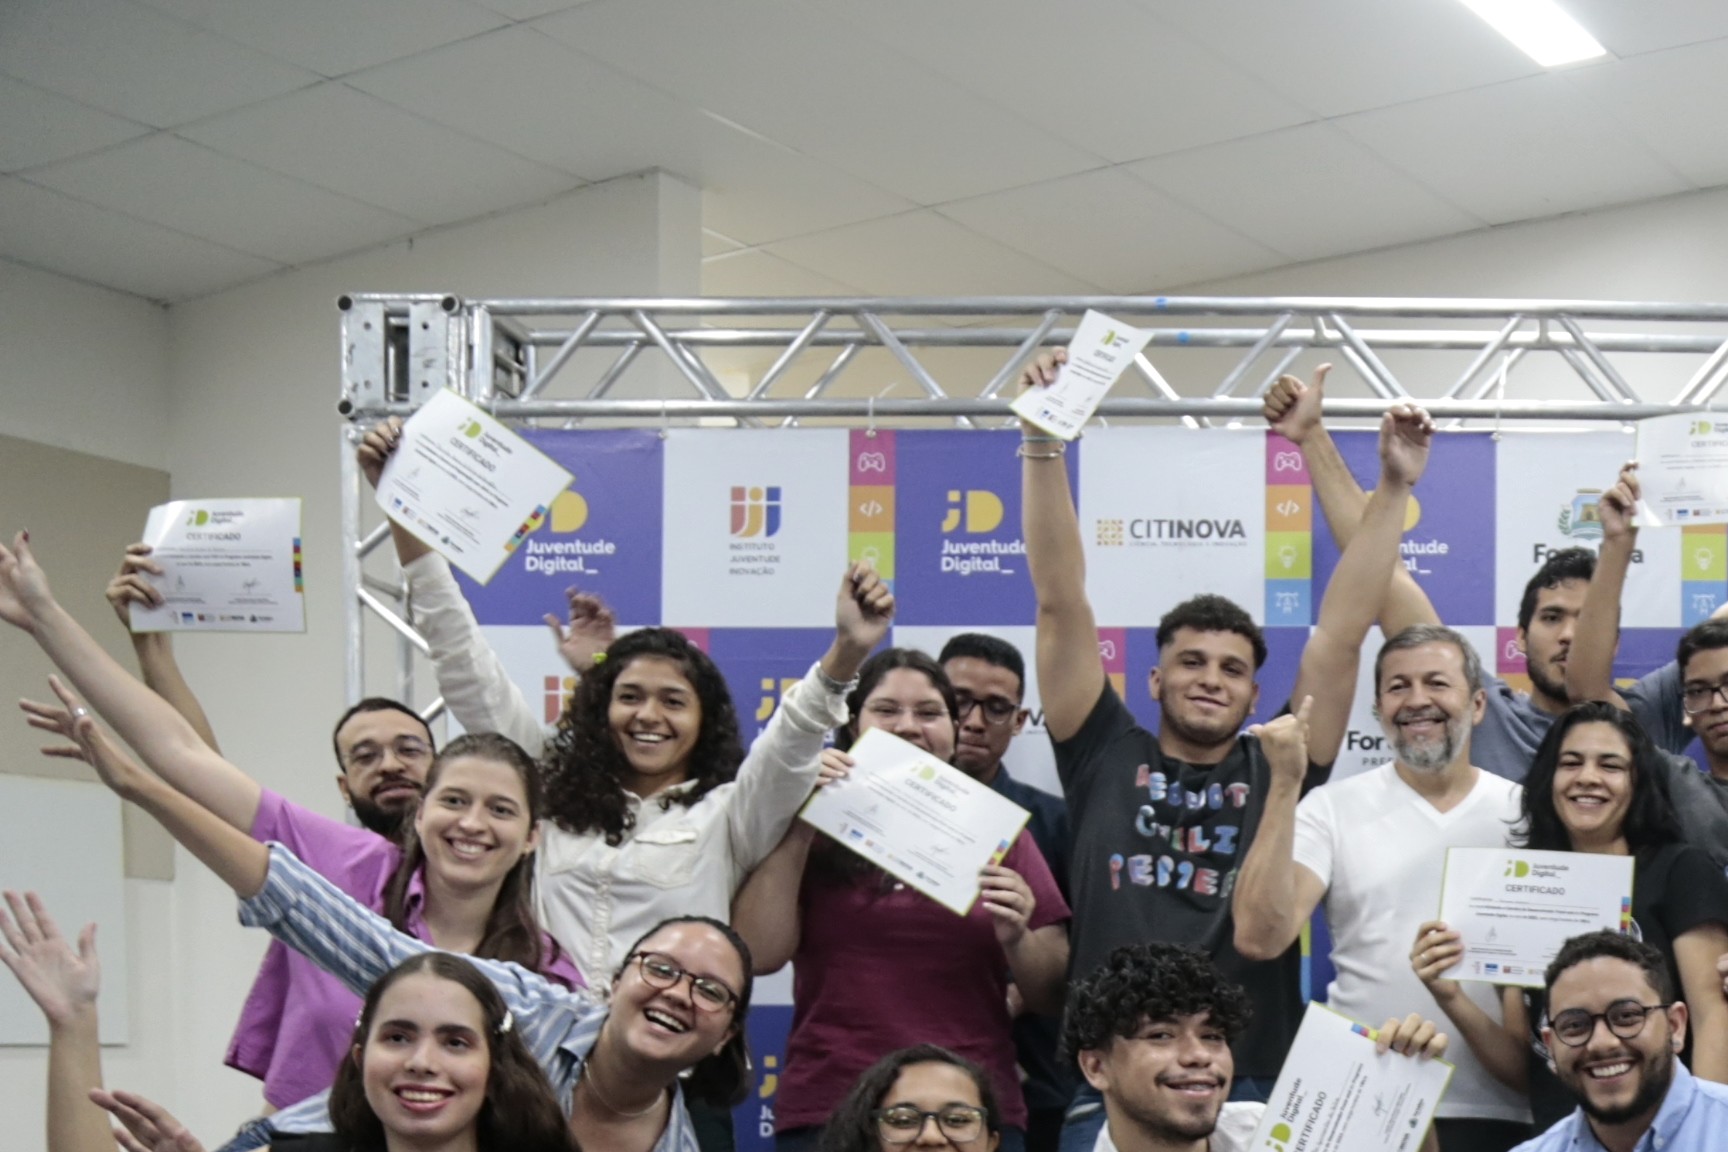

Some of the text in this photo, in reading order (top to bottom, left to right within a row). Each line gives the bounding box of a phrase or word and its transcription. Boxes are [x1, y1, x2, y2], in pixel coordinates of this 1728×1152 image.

[449, 437, 496, 472] CERTIFICADO
[1129, 519, 1246, 539] CITINOVA
[525, 538, 616, 555] Juventude
[904, 778, 957, 812] CERTIFICADO
[1532, 863, 1569, 872] Juventude
[1505, 884, 1566, 895] CERTIFICADO
[1280, 1077, 1303, 1119] Juventude
